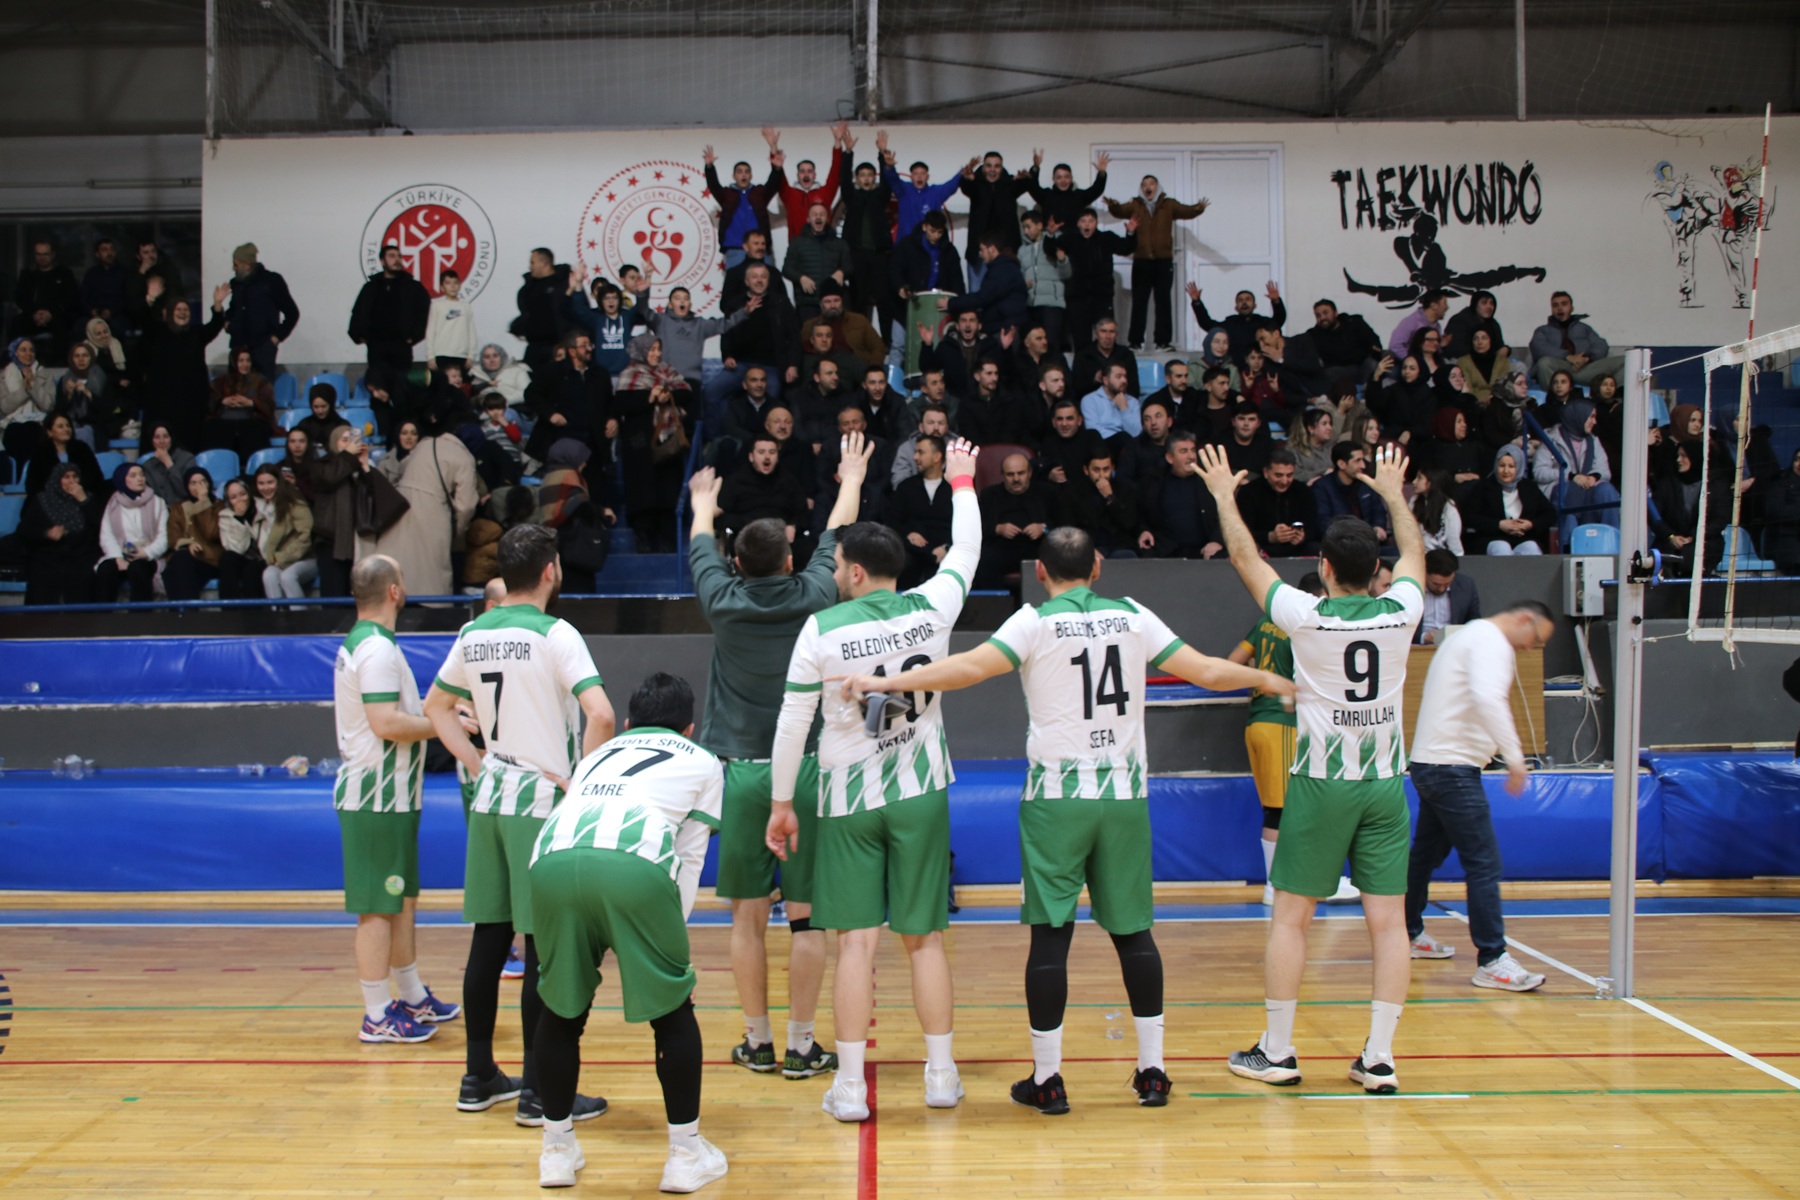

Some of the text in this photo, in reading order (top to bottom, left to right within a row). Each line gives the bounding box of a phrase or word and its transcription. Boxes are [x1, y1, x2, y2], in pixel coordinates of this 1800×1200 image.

[395, 190, 462, 210] TÜRKİYE
[1331, 160, 1542, 232] TAEKWONDO
[1098, 617, 1130, 635] SPOR
[502, 641, 531, 661] SPOR
[841, 623, 935, 660] BELEDİYE SPOR
[1071, 644, 1130, 720] 14
[1343, 640, 1380, 703] 9
[480, 671, 504, 741] 7
[1333, 705, 1395, 727] EMRULLAH
[657, 738, 695, 755] SPOR
[1090, 729, 1116, 749] SEFA
[580, 747, 675, 784] 17
[581, 783, 627, 797] EMRE
